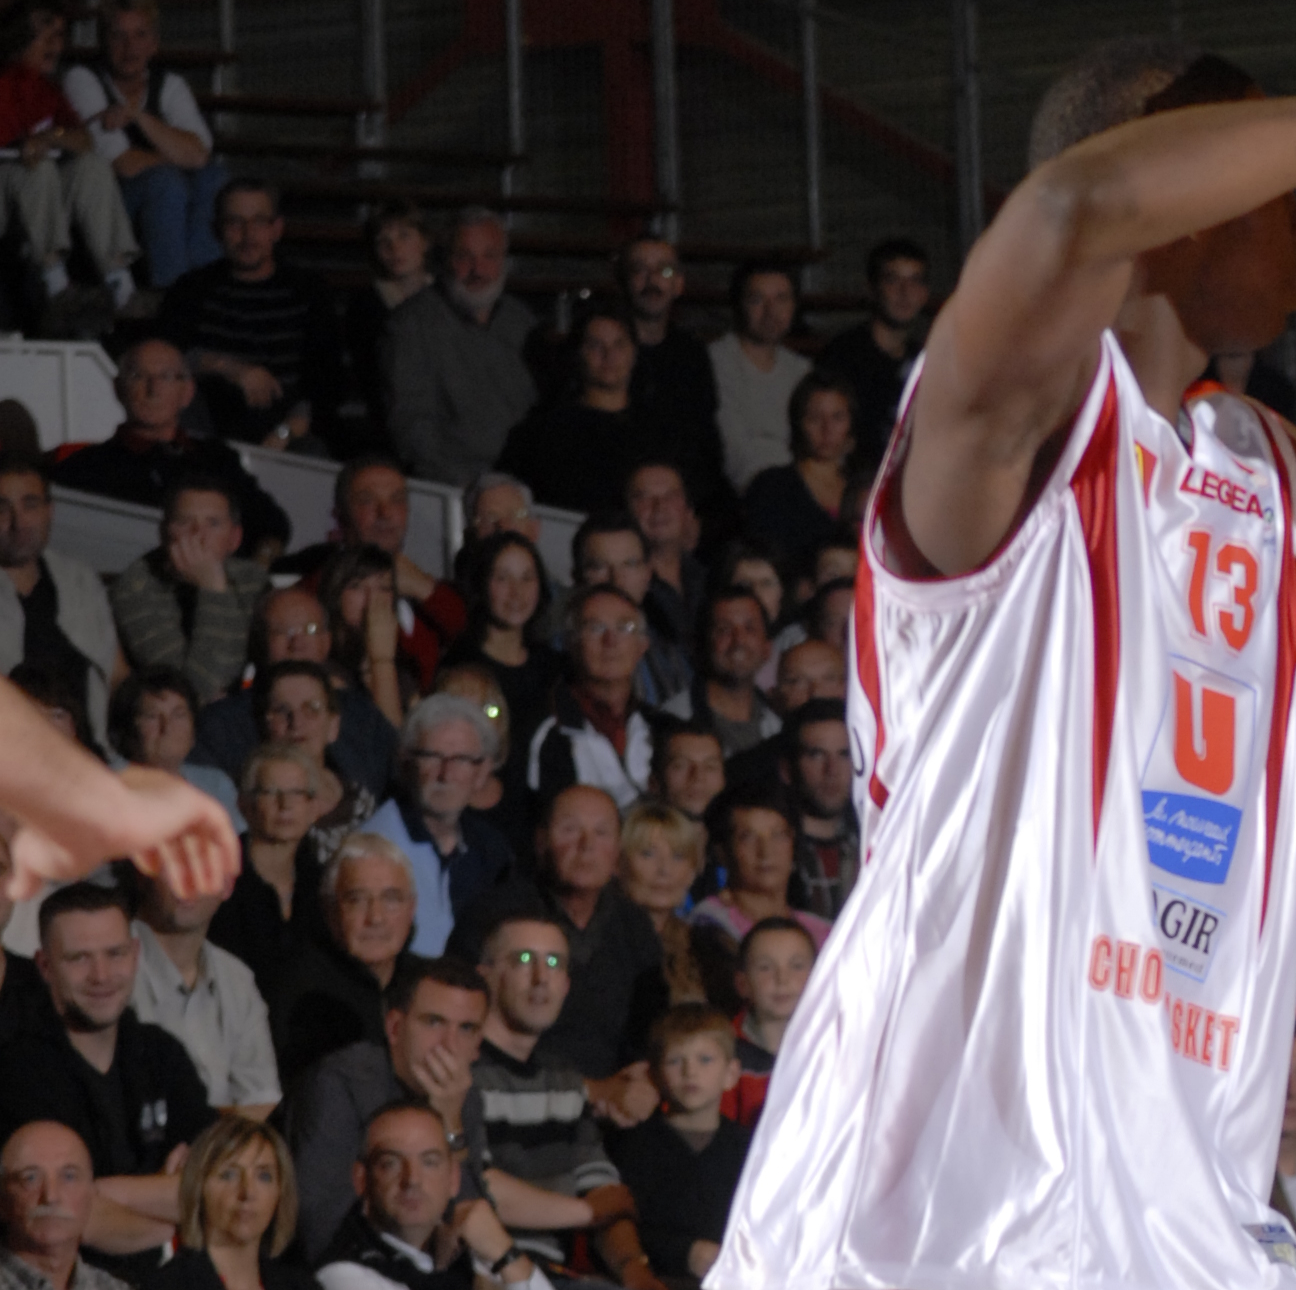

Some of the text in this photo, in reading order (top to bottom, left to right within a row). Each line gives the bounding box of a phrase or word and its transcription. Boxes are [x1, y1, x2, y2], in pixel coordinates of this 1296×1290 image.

[1179, 467, 1264, 519] LEGEA
[1187, 530, 1258, 652] 13
[1173, 669, 1236, 796] U
[1165, 991, 1241, 1072] SKET
